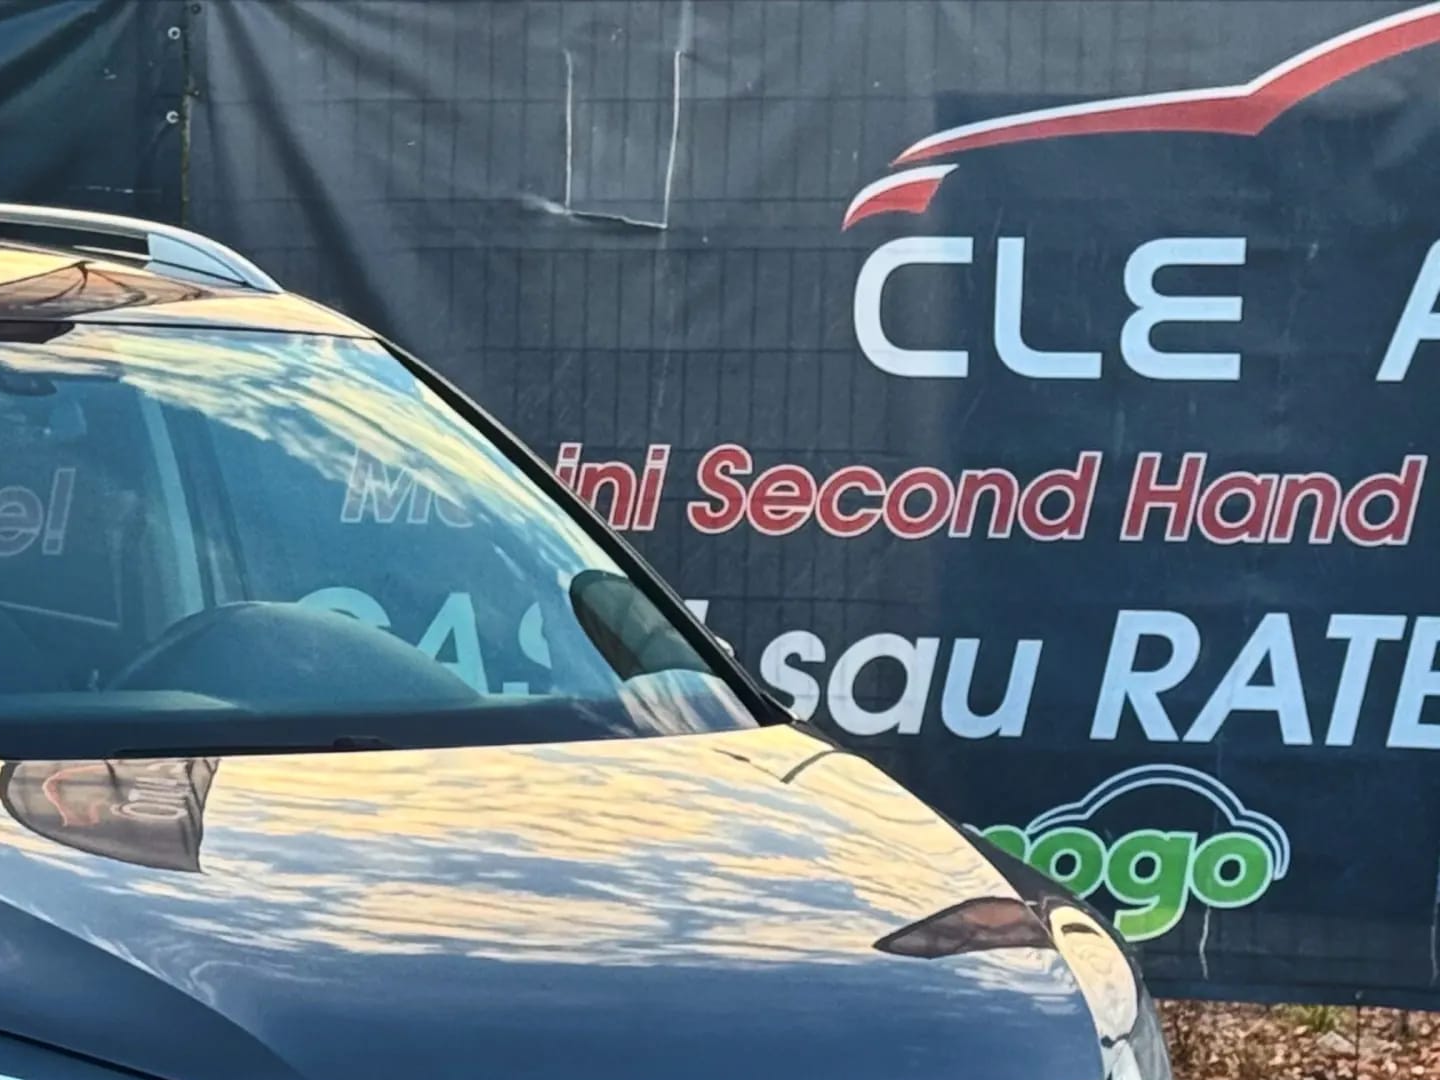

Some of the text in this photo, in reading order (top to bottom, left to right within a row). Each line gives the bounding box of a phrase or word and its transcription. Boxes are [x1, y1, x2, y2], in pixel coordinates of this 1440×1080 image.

[853, 236, 1246, 381] CLE
[688, 443, 1103, 540] Second
[1120, 451, 1427, 546] Hand
[759, 627, 1044, 739] sau
[962, 823, 1274, 942] ogo
